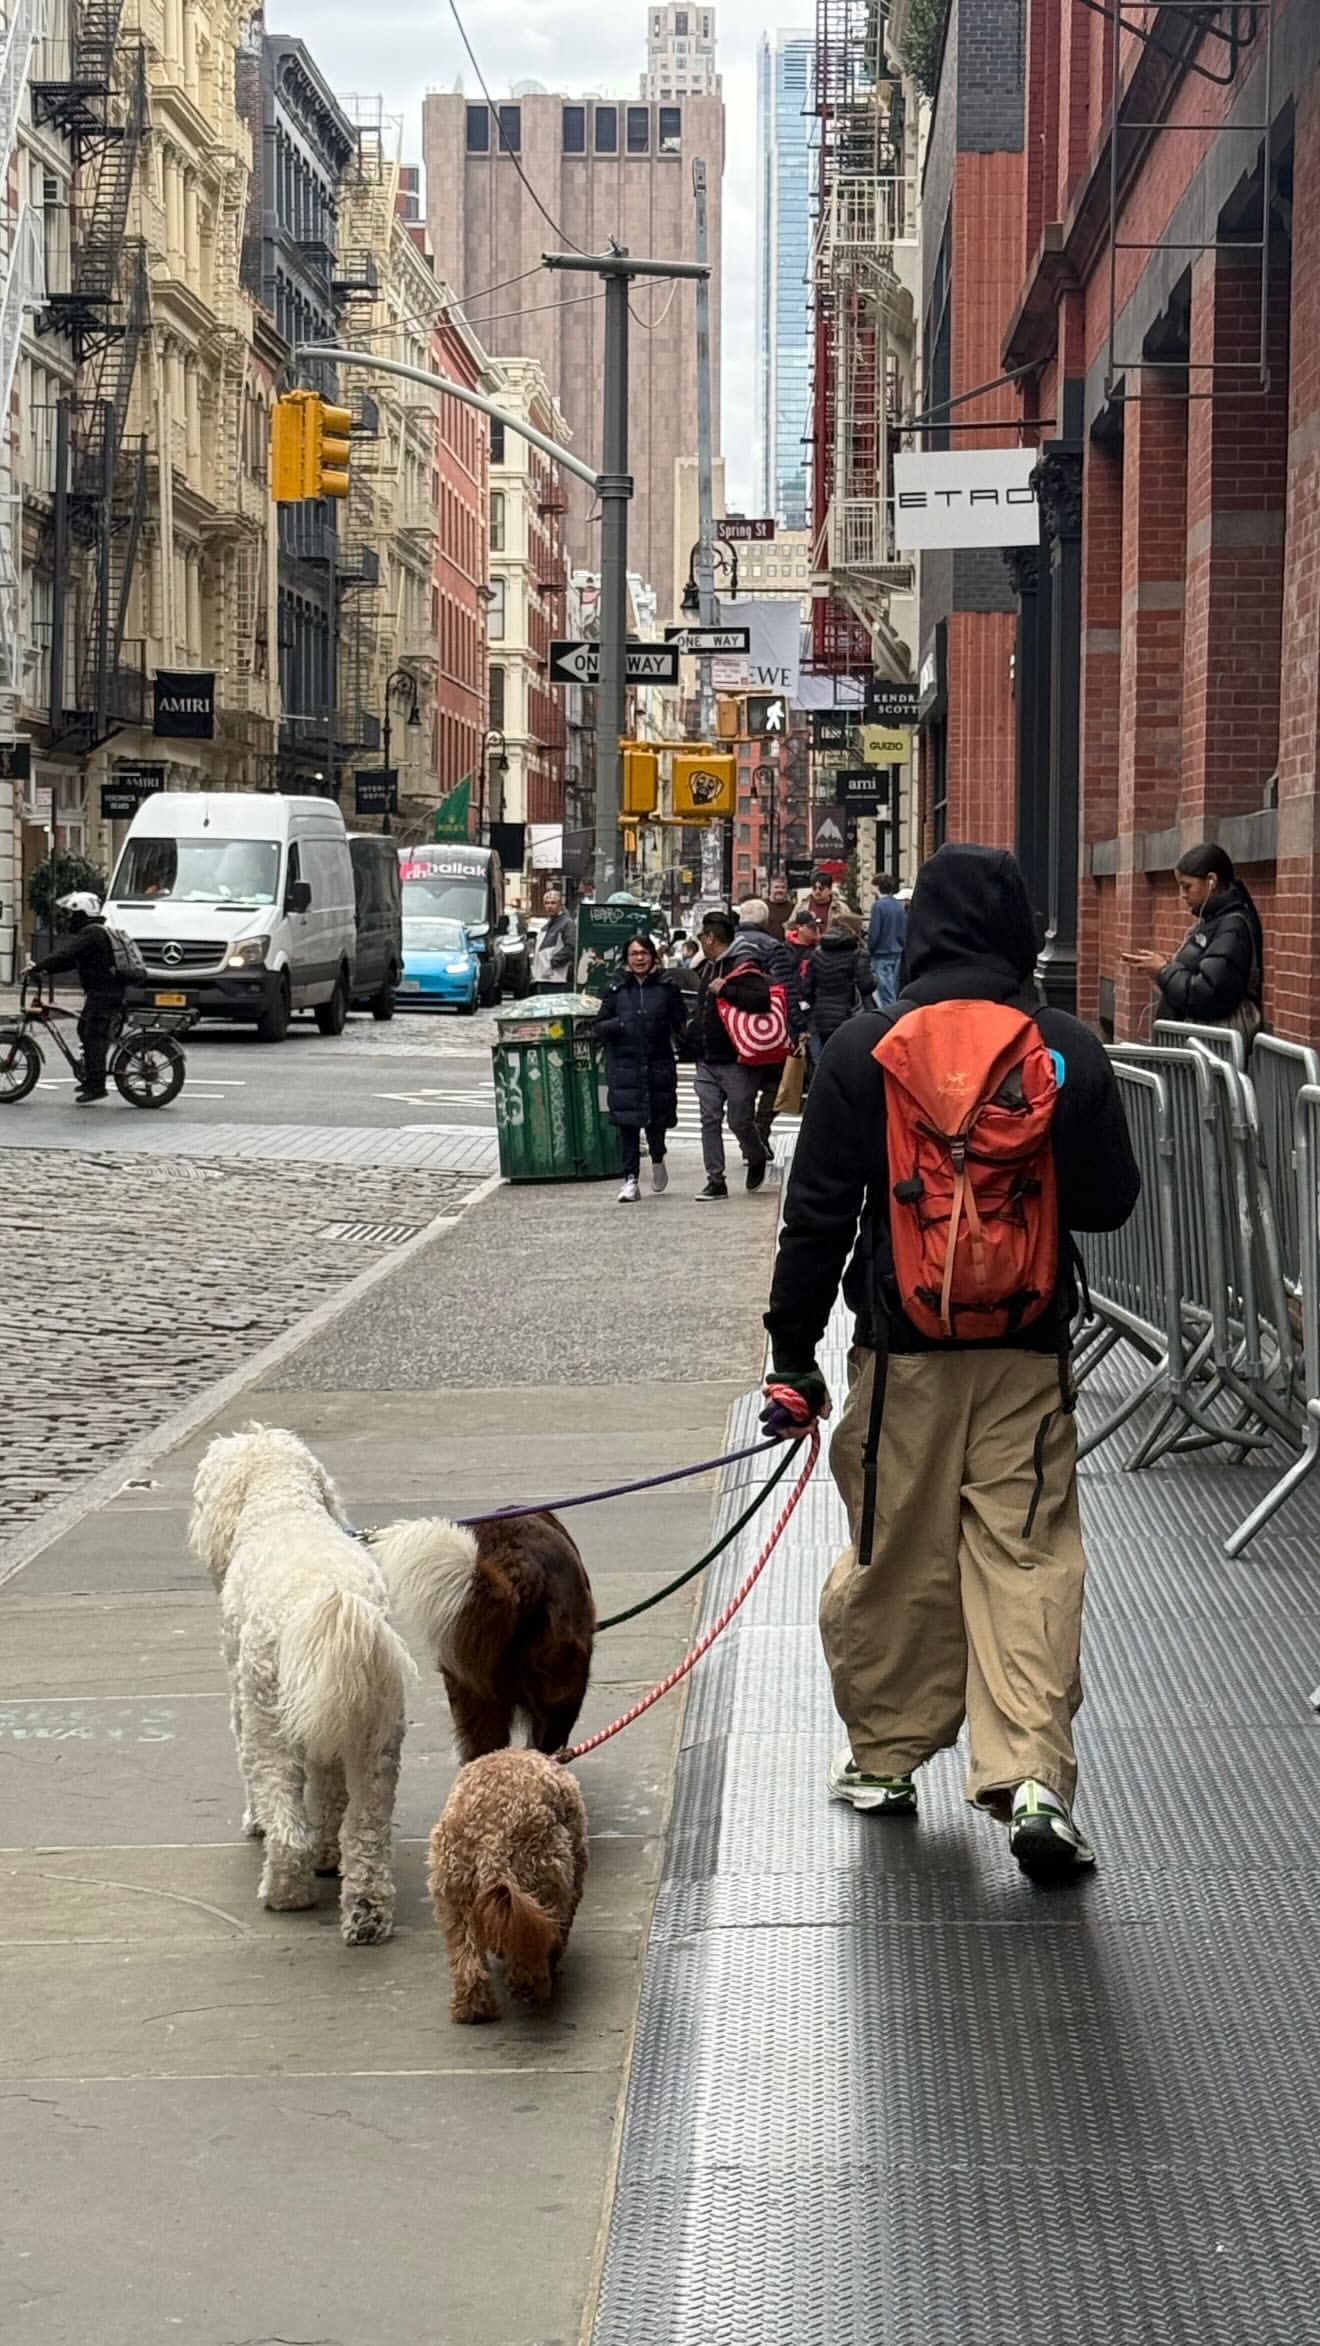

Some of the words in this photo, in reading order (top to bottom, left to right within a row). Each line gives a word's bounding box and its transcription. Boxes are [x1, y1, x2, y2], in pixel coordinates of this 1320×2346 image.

[719, 522, 752, 540] Spring
[754, 522, 767, 537] St
[679, 635, 702, 648] ONE
[713, 635, 740, 647] WAY
[574, 655, 598, 672] ON
[628, 655, 665, 673] WAY
[159, 697, 210, 713] AMIRI
[878, 705, 918, 714] SCOTT
[848, 776, 877, 790] ami
